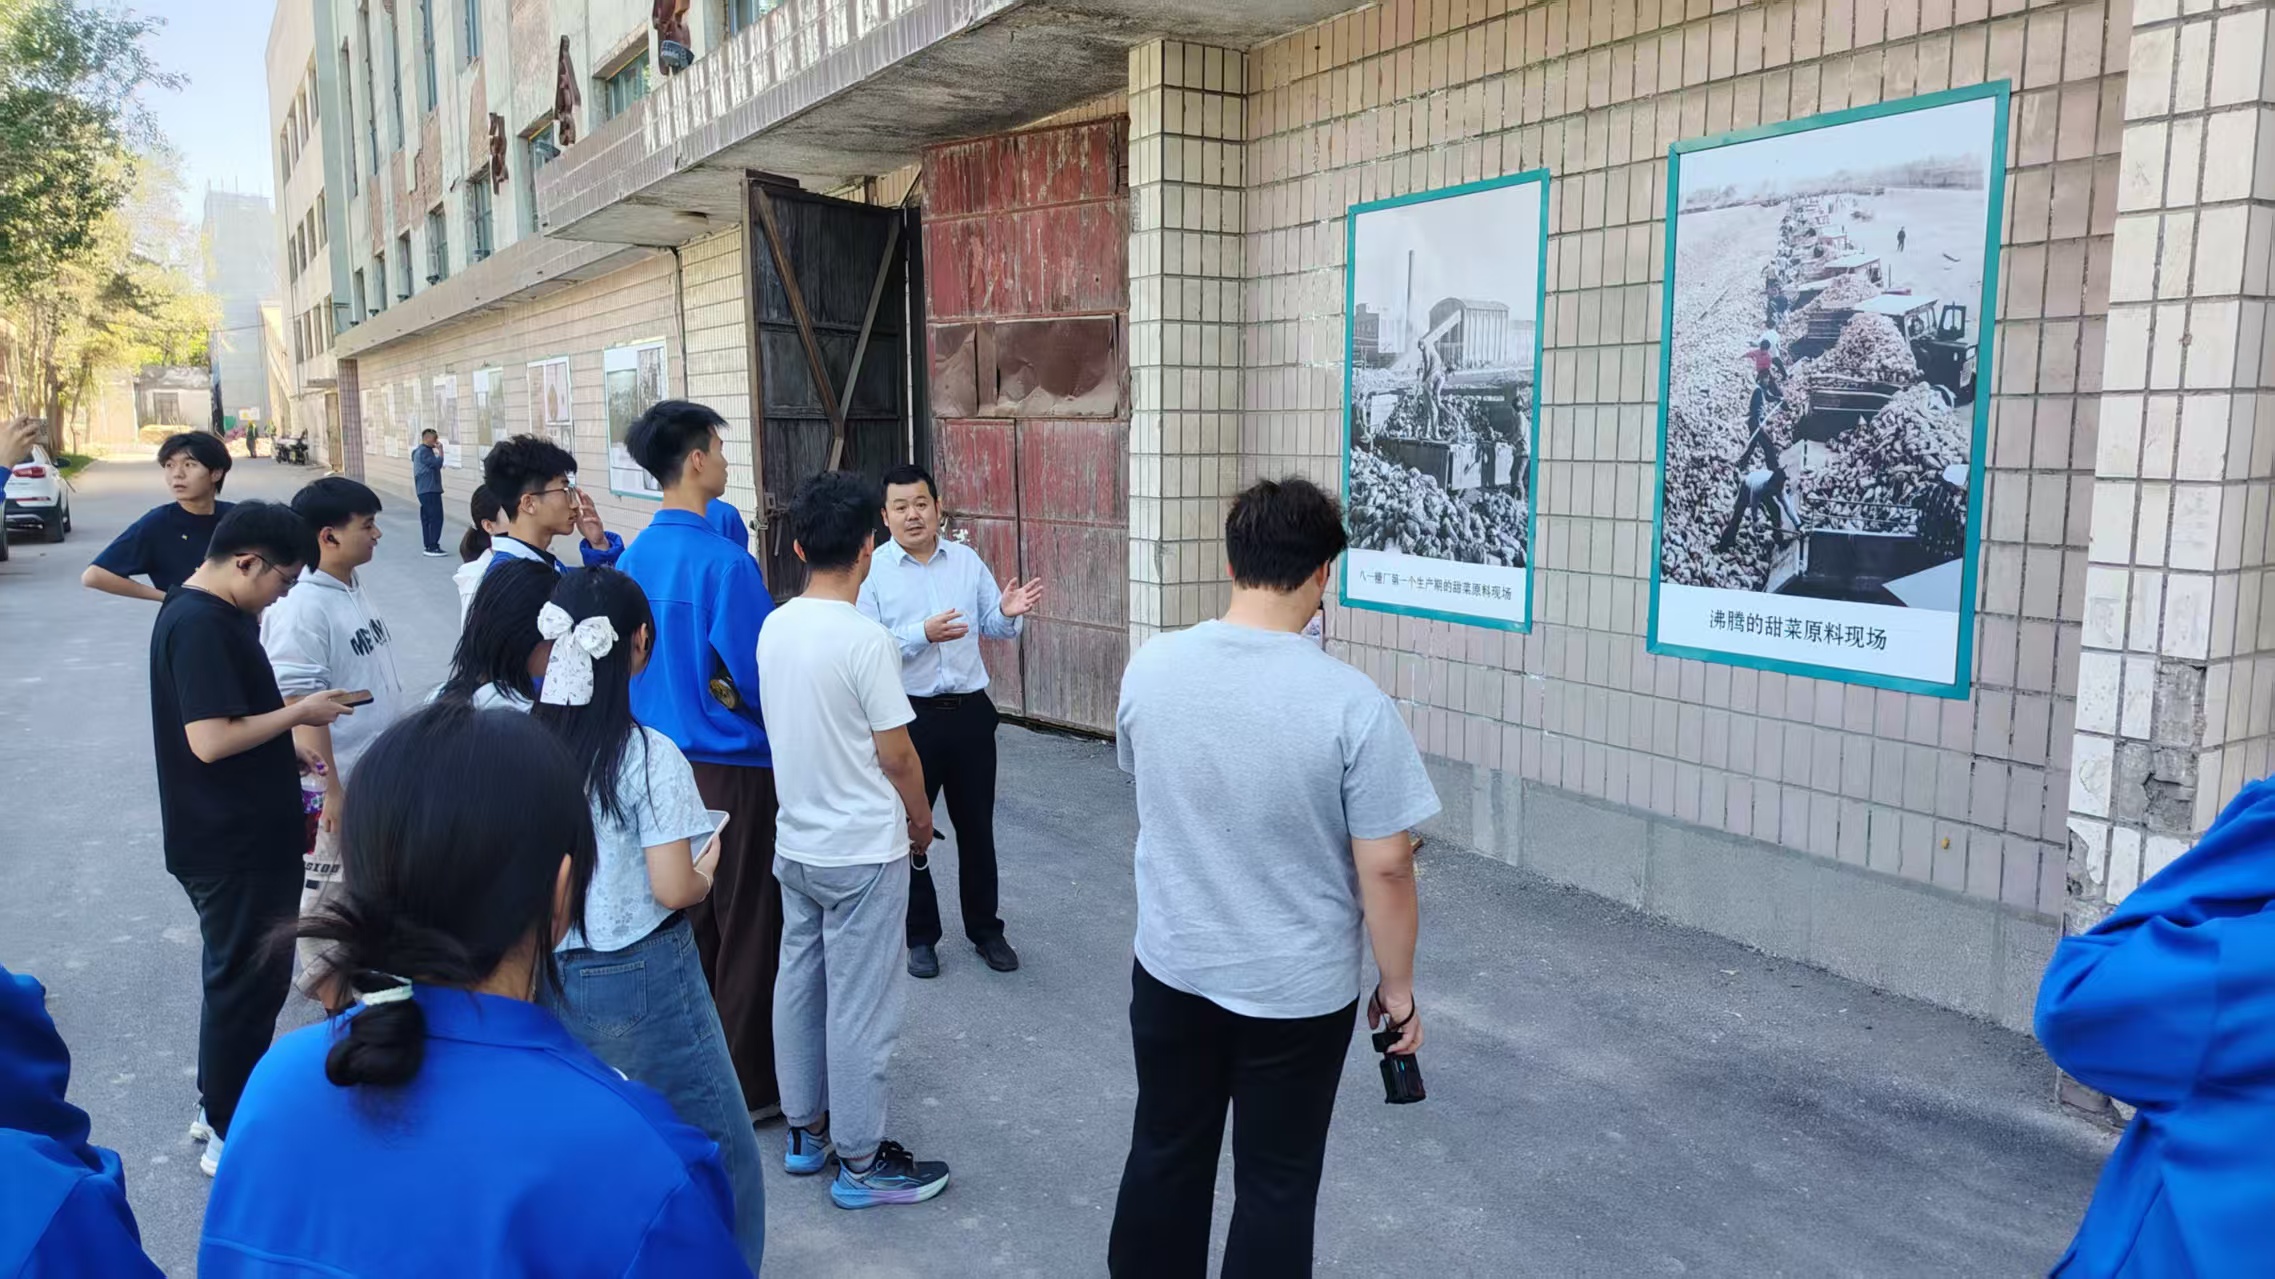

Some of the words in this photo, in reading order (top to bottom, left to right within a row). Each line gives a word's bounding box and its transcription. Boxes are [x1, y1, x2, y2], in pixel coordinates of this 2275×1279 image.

[1709, 608, 1887, 650] 沸腾的甜菜原料现场
